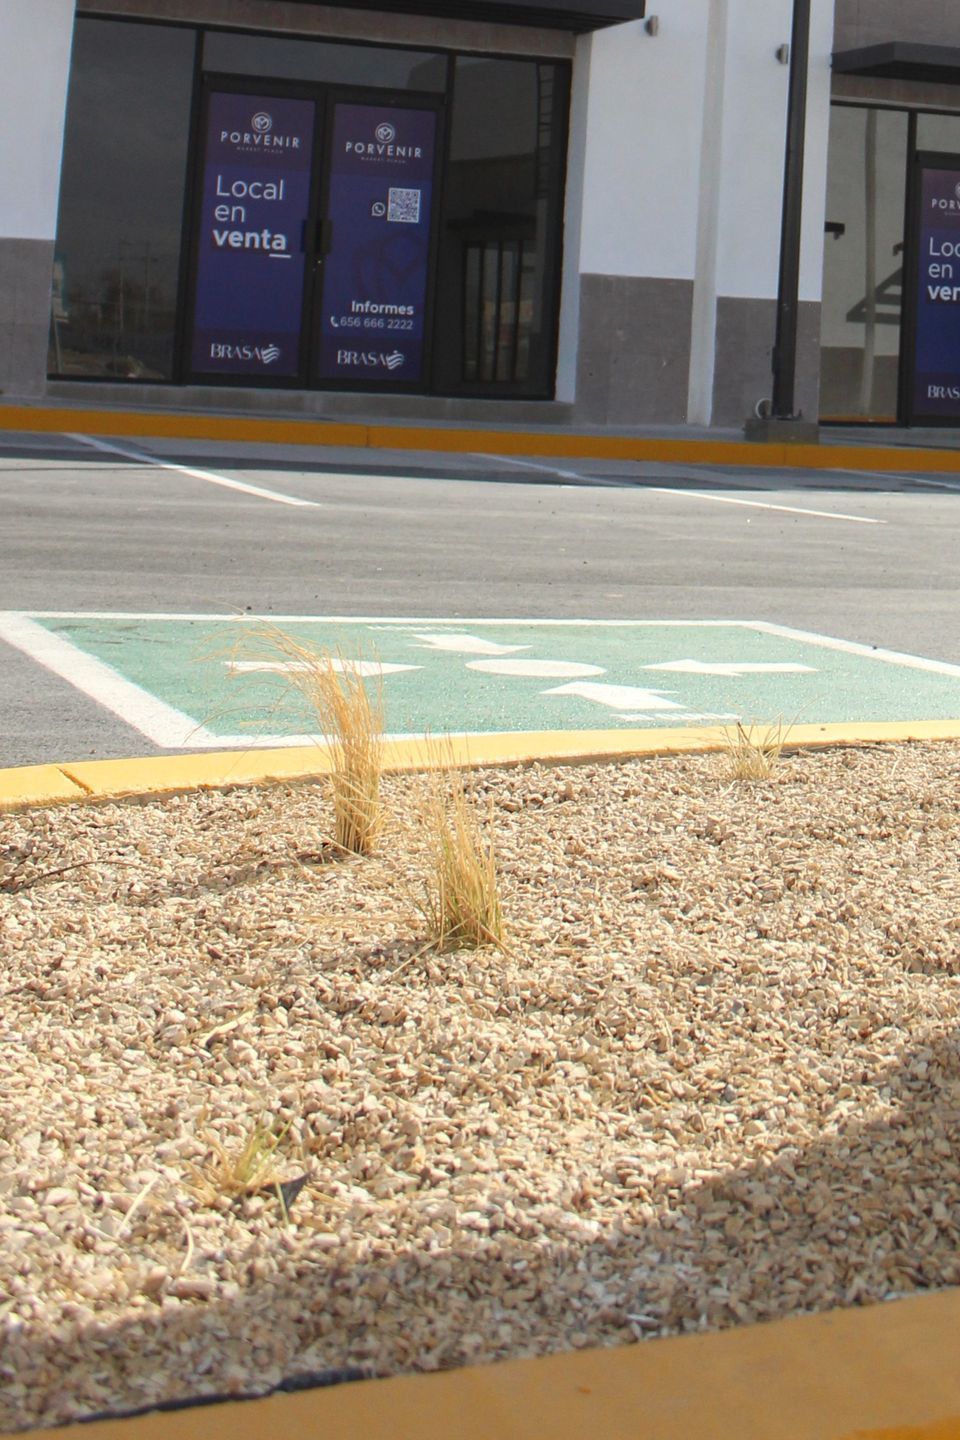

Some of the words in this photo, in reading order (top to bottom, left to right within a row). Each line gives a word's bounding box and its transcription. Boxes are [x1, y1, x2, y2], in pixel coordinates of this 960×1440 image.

[220, 130, 300, 148] PORVENIR
[345, 141, 422, 158] PORVENIR
[216, 174, 284, 201] Local
[214, 204, 246, 223] en
[212, 229, 286, 251] venta
[928, 263, 953, 278] en
[351, 300, 415, 315] Informes
[340, 316, 361, 328] 656
[387, 319, 414, 330] 2222
[210, 343, 261, 360] BRASA
[337, 350, 387, 366] BRASA
